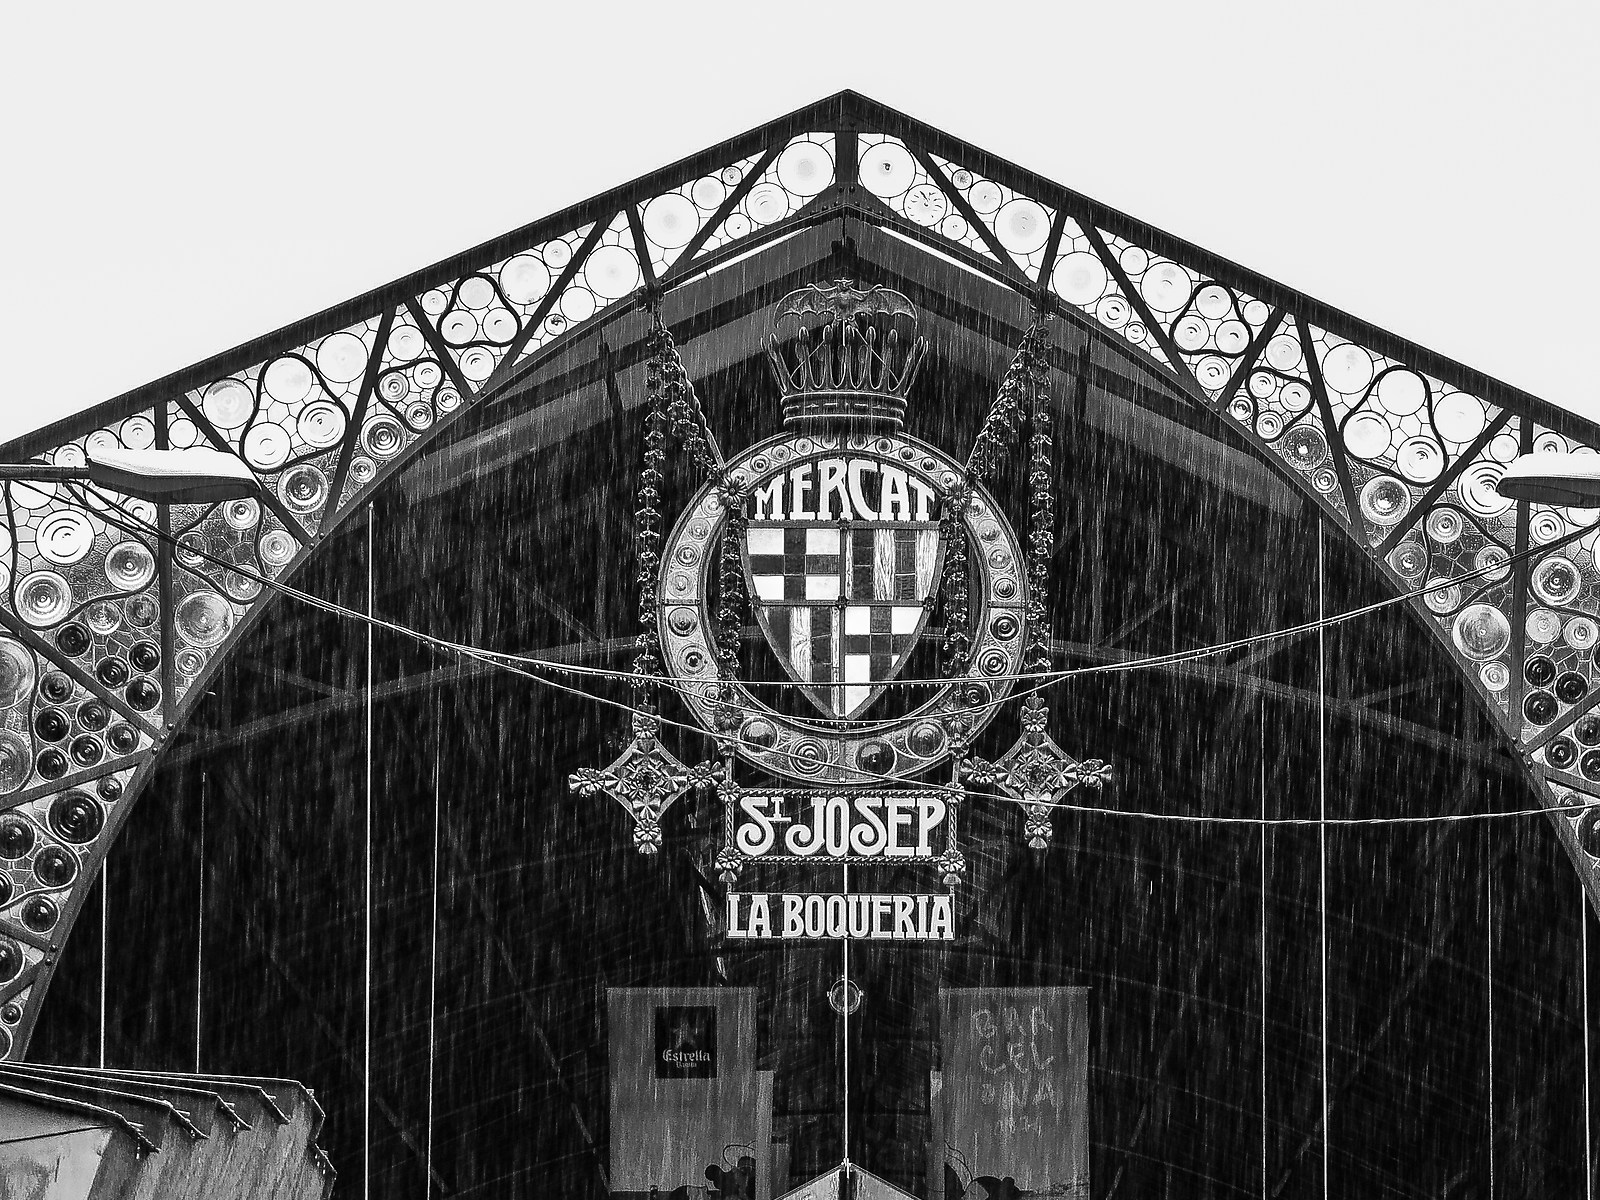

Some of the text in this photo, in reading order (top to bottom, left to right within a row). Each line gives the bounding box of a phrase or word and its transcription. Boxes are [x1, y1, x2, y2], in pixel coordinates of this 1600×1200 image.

[754, 457, 935, 522] MERCAT
[785, 797, 946, 856] JOSEP
[728, 894, 954, 939] LA BOQUERIA
[662, 1049, 710, 1062] Estrella
